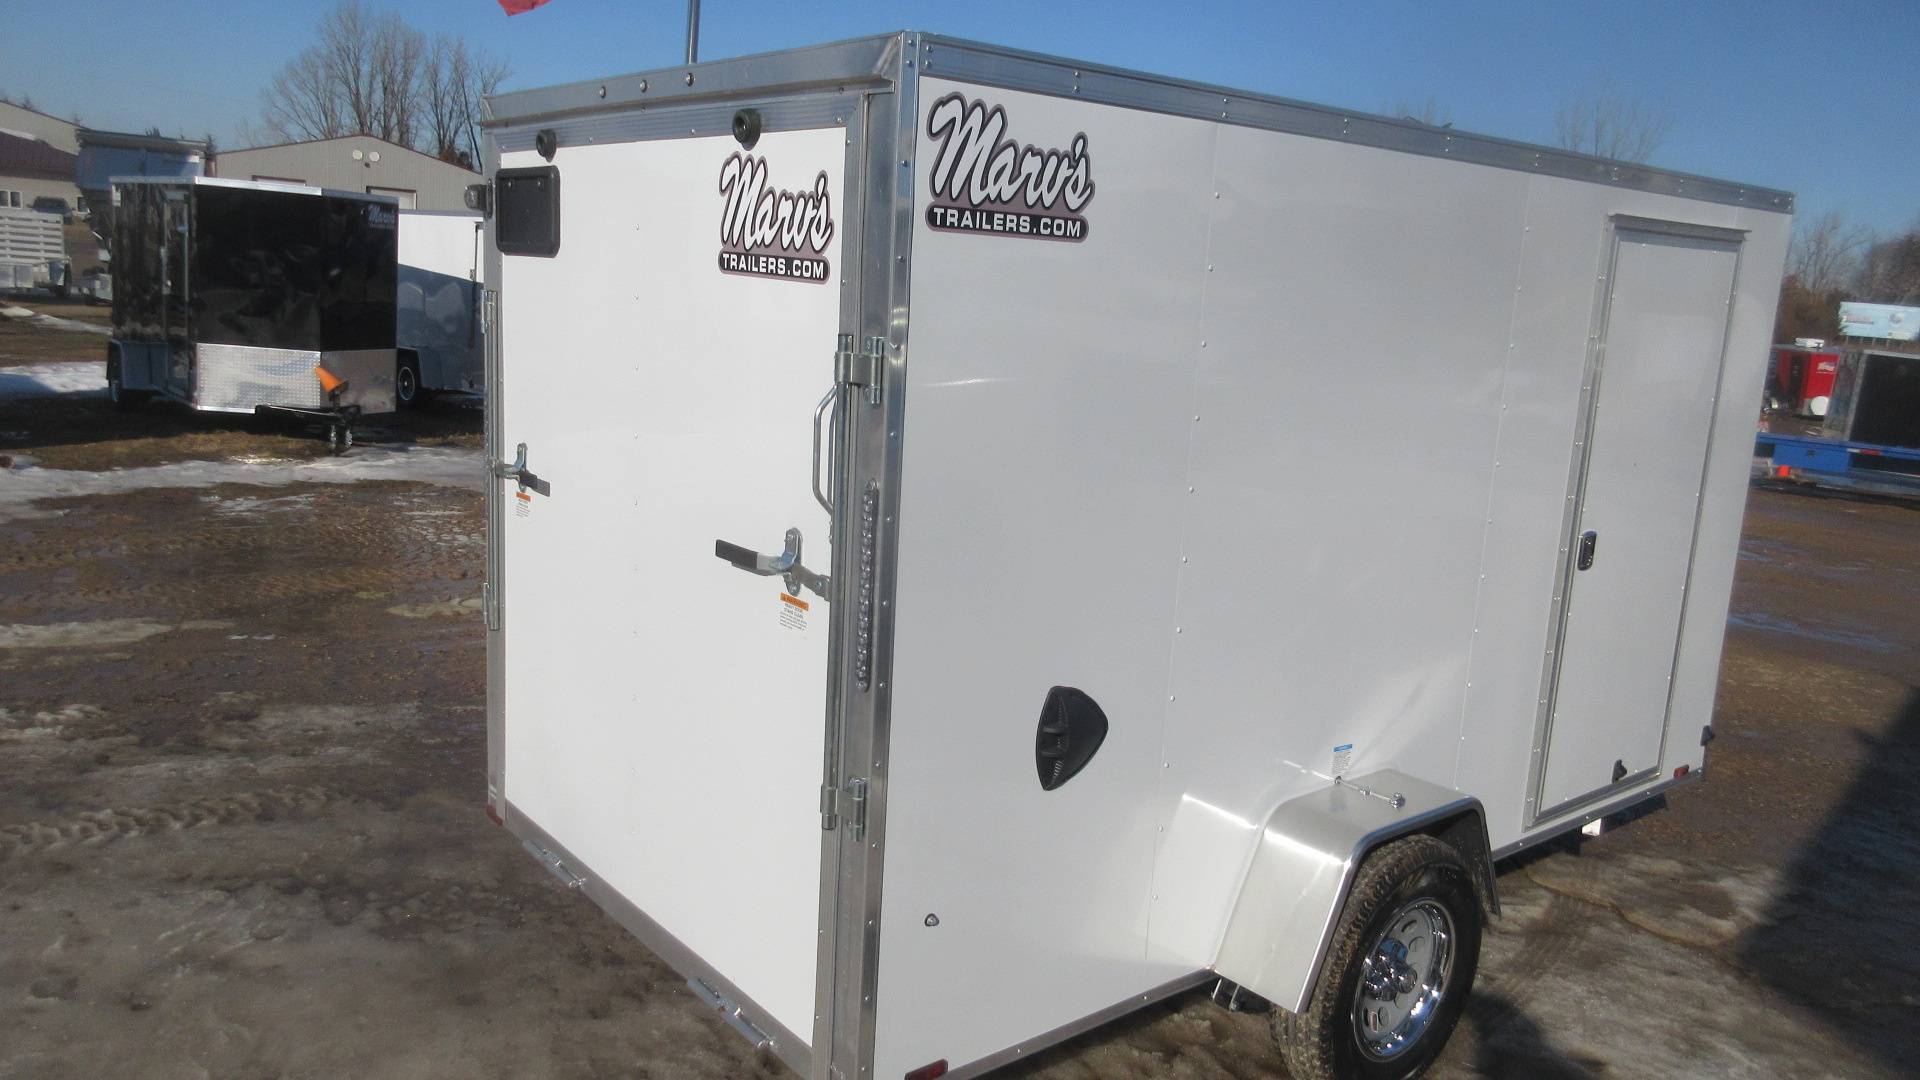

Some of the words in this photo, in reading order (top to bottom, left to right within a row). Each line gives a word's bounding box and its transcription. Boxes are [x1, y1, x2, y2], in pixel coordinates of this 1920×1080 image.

[929, 96, 1093, 211] Marv's
[721, 154, 833, 252] Marv's
[933, 207, 1081, 237] TRAILERS.COM
[722, 253, 824, 279] TRAILERS.COM
